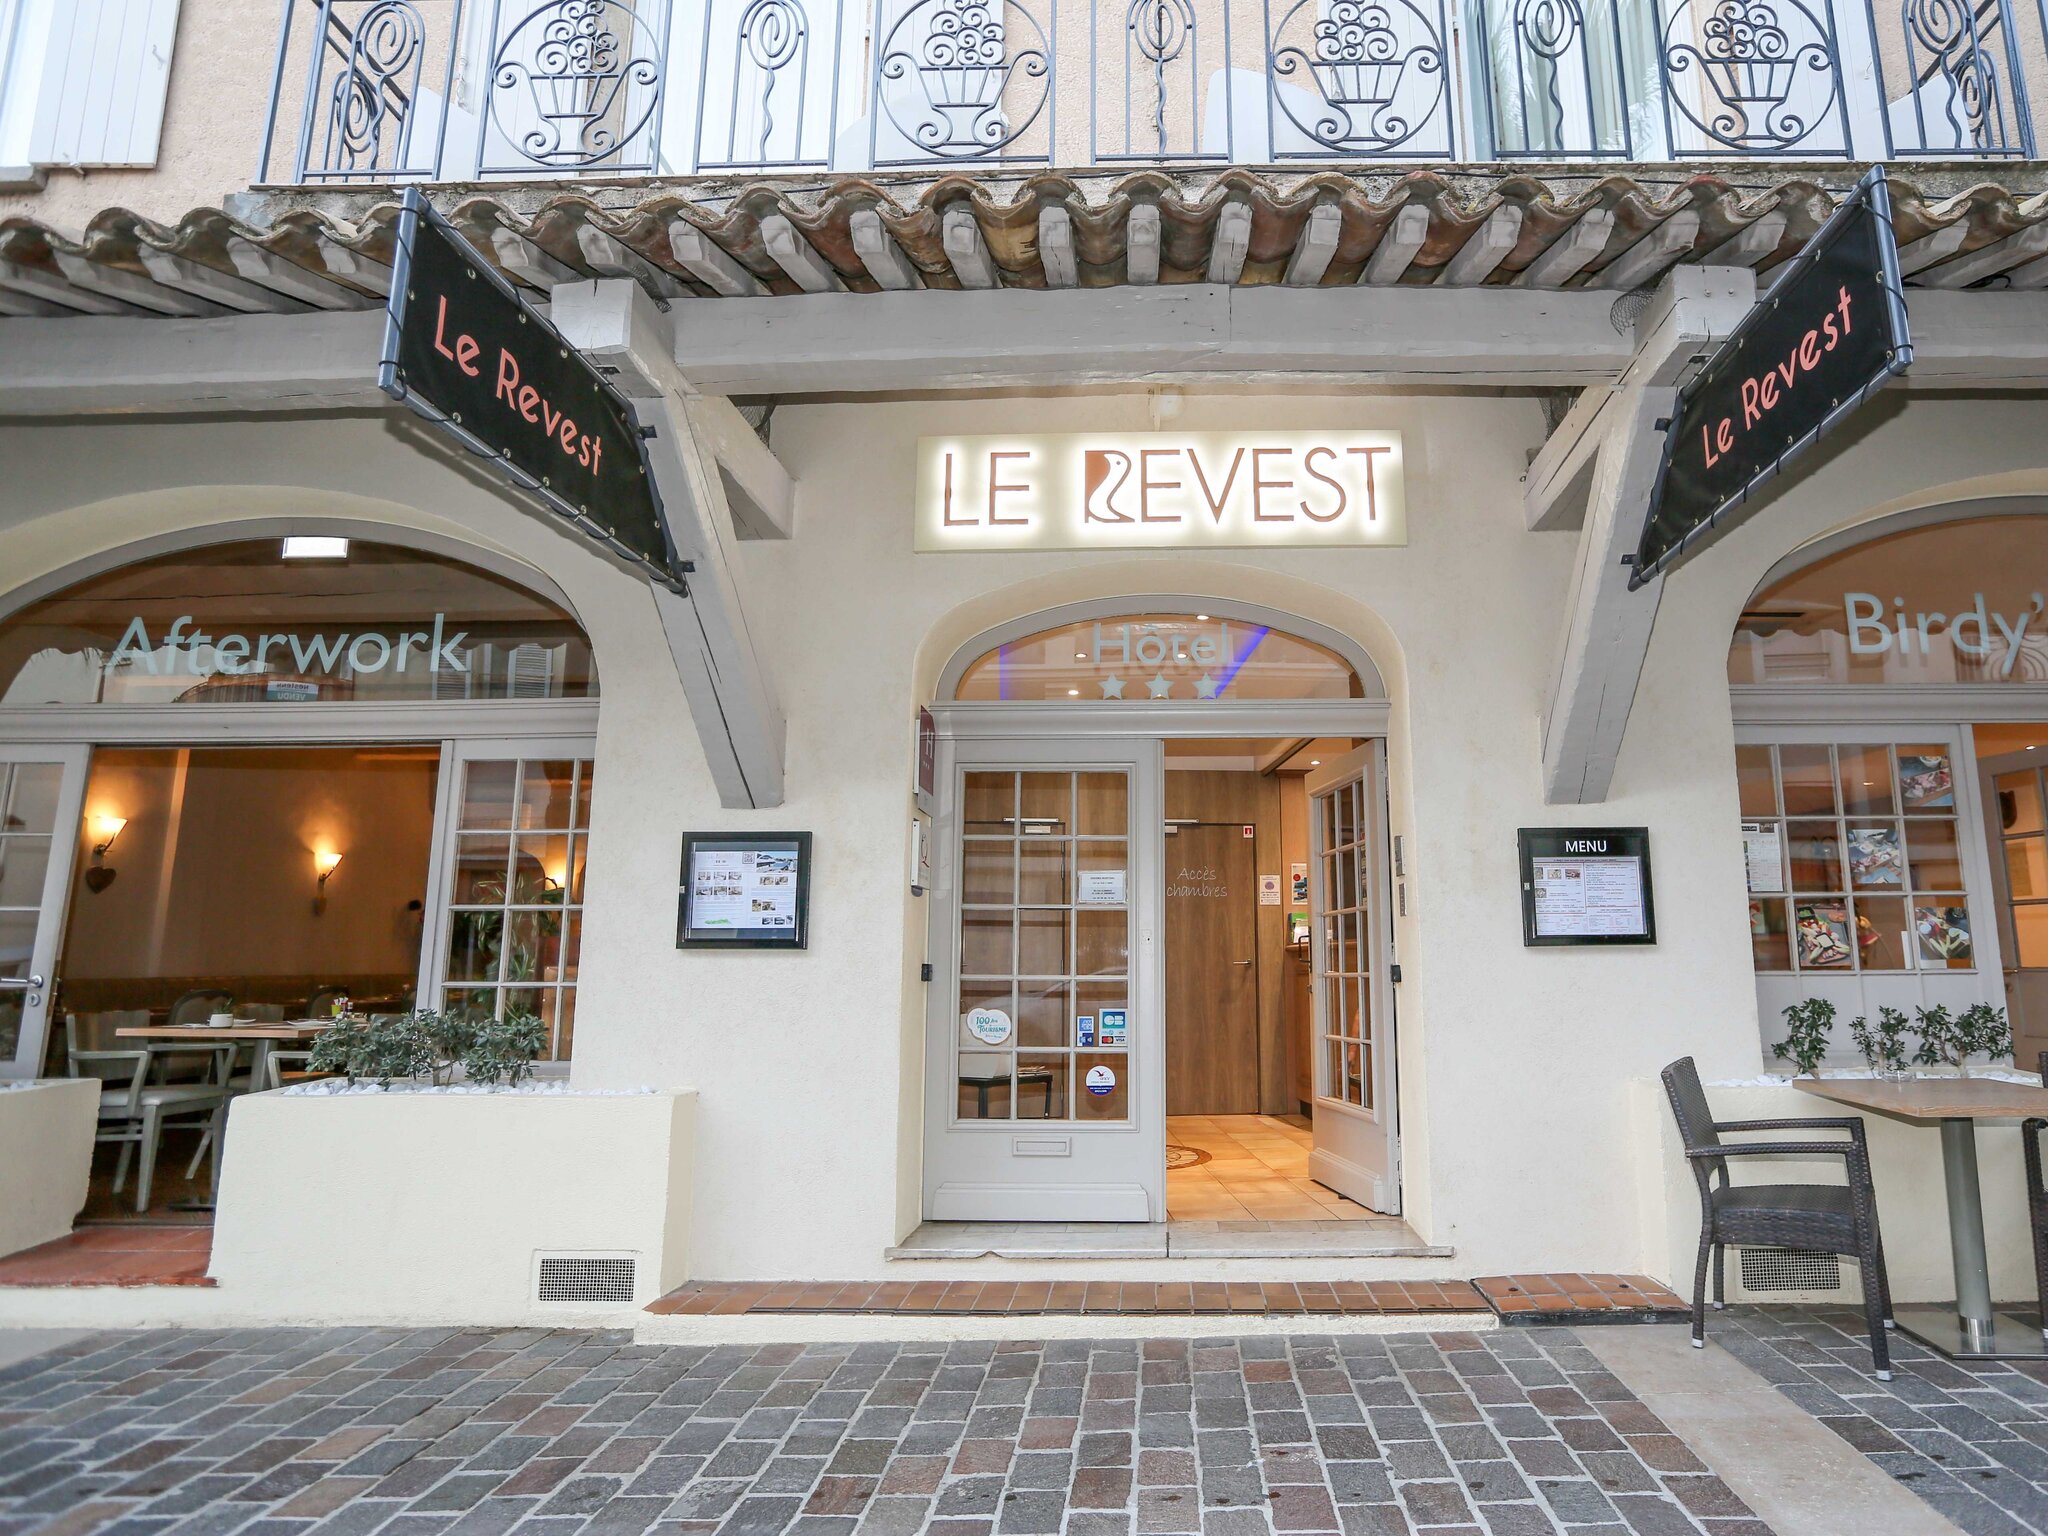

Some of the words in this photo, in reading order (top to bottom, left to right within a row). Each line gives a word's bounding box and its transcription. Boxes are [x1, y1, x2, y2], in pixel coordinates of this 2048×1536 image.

[434, 295, 480, 377] Le
[496, 347, 602, 476] Revest
[1702, 416, 1734, 470] Le
[1740, 285, 1853, 432] Revest
[944, 451, 1031, 527] LE
[1084, 446, 1392, 525] REVEST
[104, 612, 469, 676] Afterwork
[1091, 621, 1230, 668] Hôtel
[1564, 839, 1607, 853] MENU
[1166, 882, 1229, 897] chambres
[1176, 865, 1217, 880] Accès
[976, 1016, 990, 1025] 100
